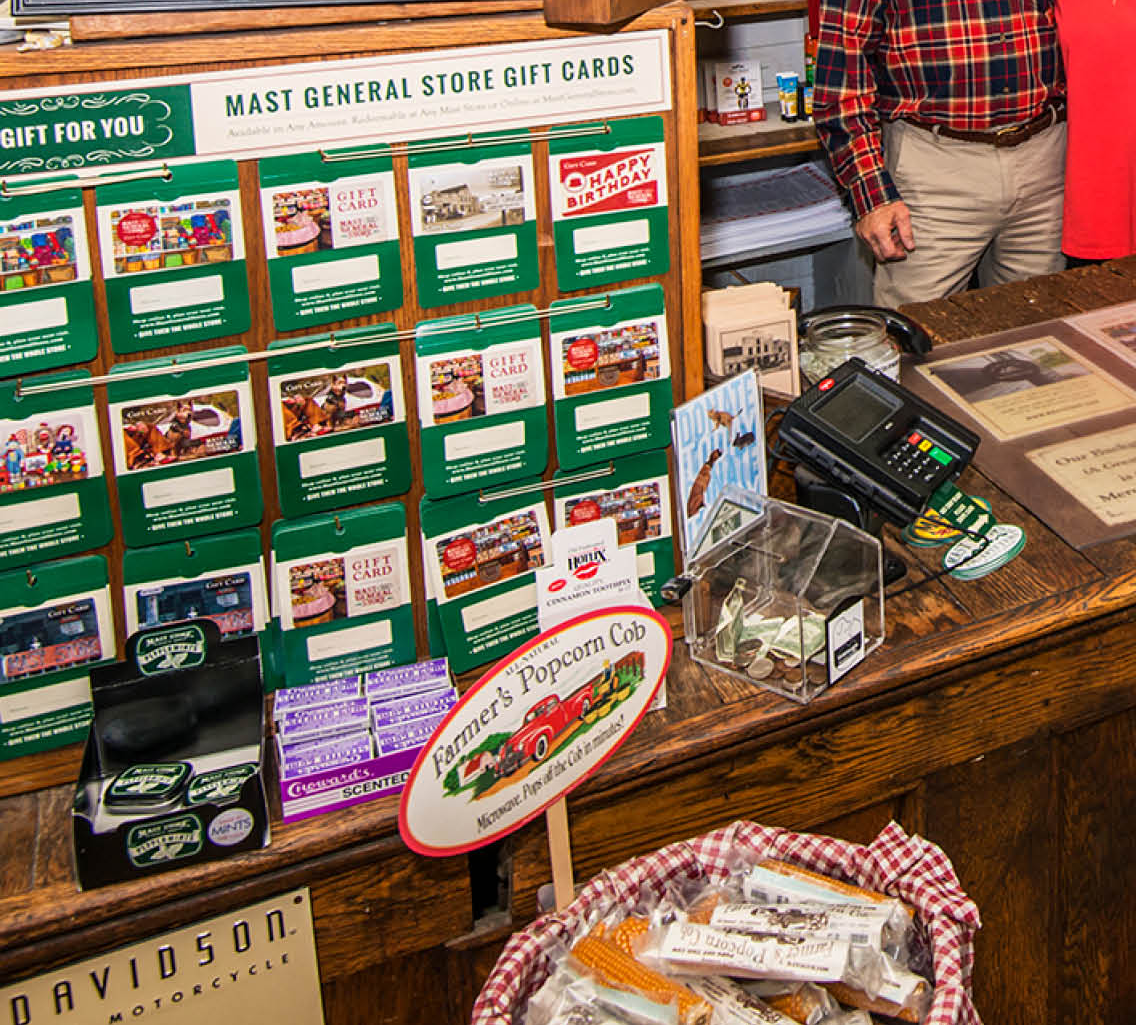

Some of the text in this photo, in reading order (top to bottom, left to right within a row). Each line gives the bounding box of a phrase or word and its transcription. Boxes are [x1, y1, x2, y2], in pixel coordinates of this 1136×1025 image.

[226, 54, 635, 117] MAST GENERAL STORE GIFT CARDS
[1, 115, 144, 149] GIFT FOR YOU
[590, 155, 651, 189] HAPPY
[337, 188, 376, 201] GIFT
[567, 168, 651, 209] BIRTHDAY
[337, 198, 378, 213] CARD
[490, 352, 527, 369] GIFT
[490, 362, 528, 379] CARD
[1056, 454, 1087, 467] Our
[1120, 473, 1133, 482] is
[352, 555, 391, 571] GIFT
[353, 565, 393, 582] CARD
[432, 687, 513, 781] Farmer's
[516, 634, 606, 695] Popcorn
[610, 620, 646, 648] Cob
[523, 779, 541, 801] Pops
[541, 768, 554, 787] off
[554, 759, 568, 776] the
[568, 748, 584, 769] Cob
[585, 742, 594, 755] in
[594, 714, 627, 752] minutes!
[343, 772, 409, 799] SCENTED
[211, 819, 251, 837] MINTS
[704, 934, 766, 967] Popcorn
[10, 909, 287, 1025] DAVIDSON
[109, 952, 290, 1025] MOTORCYCLE
